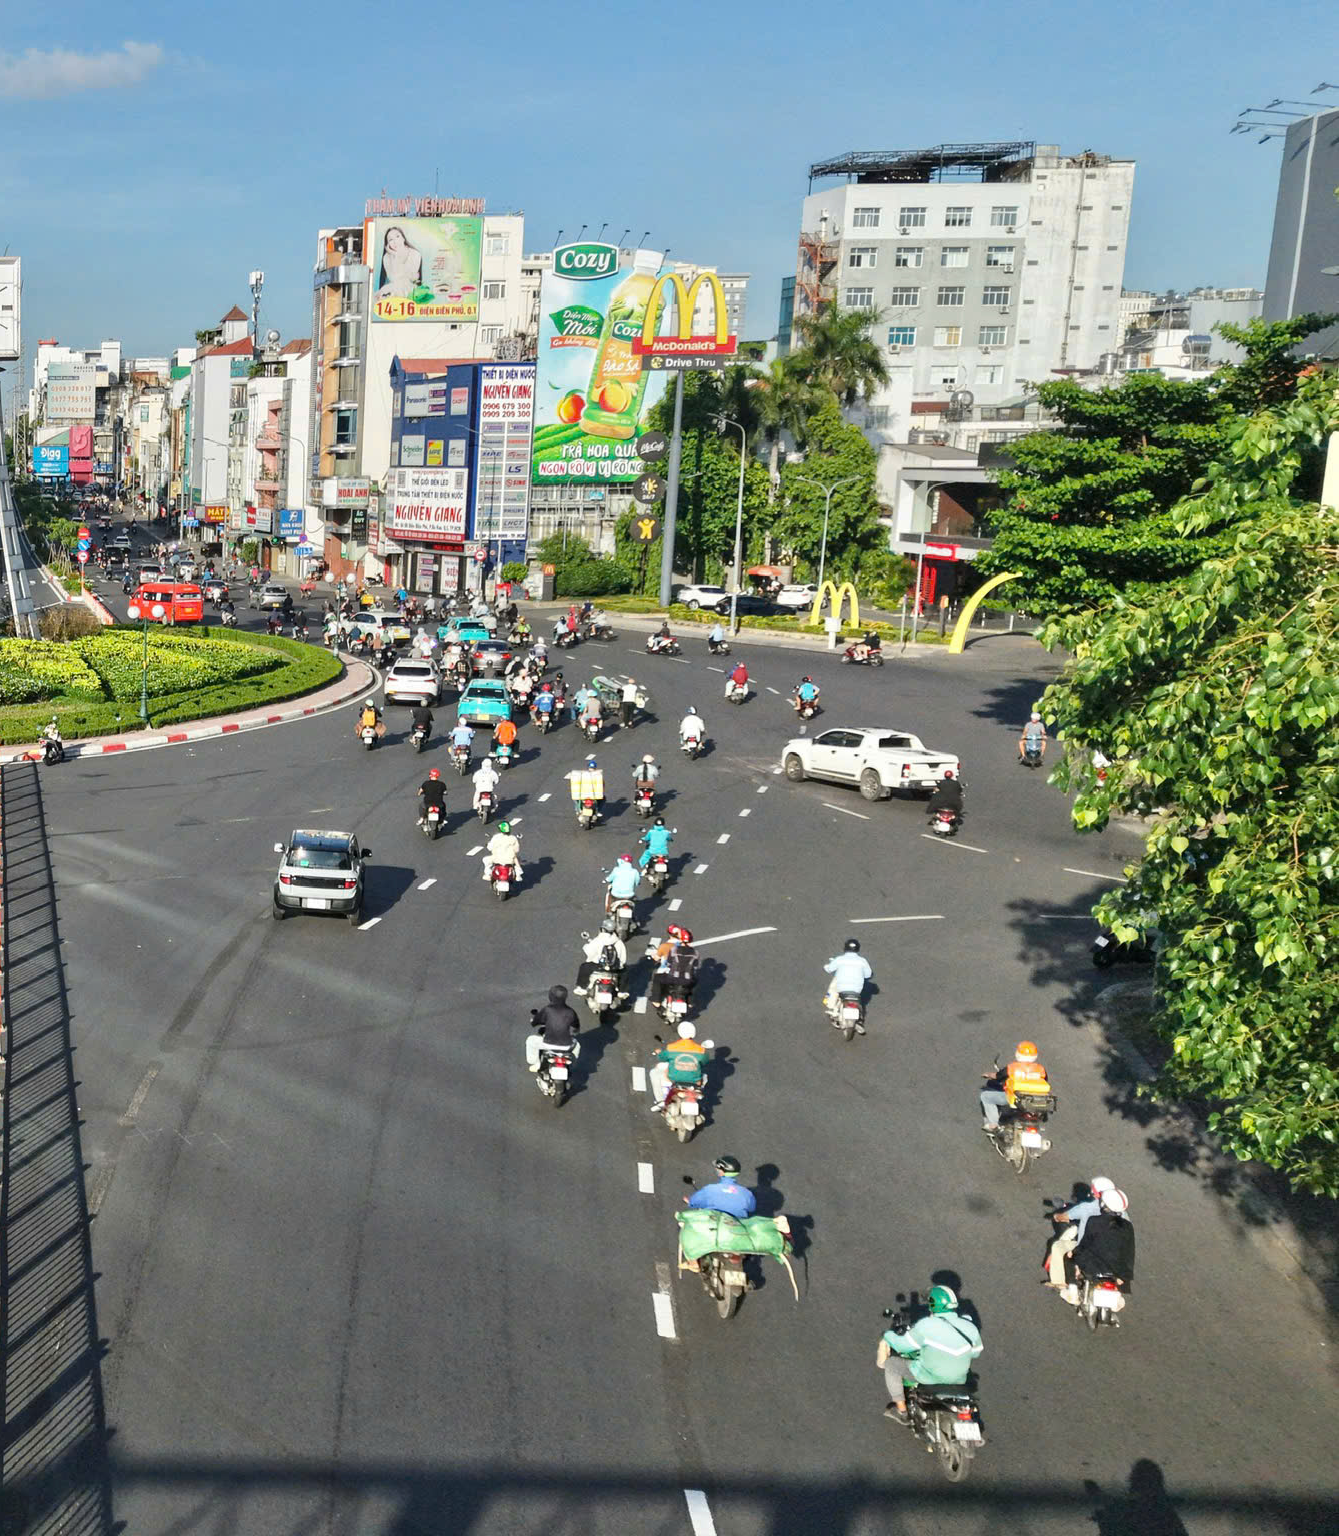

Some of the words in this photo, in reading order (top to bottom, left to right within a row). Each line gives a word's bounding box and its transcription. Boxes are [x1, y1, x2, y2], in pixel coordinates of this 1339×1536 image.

[561, 250, 612, 272] Cozy
[376, 302, 415, 316] 14-16
[563, 320, 598, 335] Mới
[652, 341, 716, 351] McDonald's
[665, 358, 692, 368] Drive
[695, 358, 716, 367] Thru
[512, 385, 532, 399] GIANG
[562, 441, 582, 457] TRÀ
[587, 444, 609, 457] HOA
[508, 465, 522, 473] LS
[540, 463, 565, 474] NGON
[586, 463, 595, 475] VỊ
[600, 463, 610, 477] VỊ
[354, 488, 368, 497] ANH
[434, 506, 462, 522] GIANG
